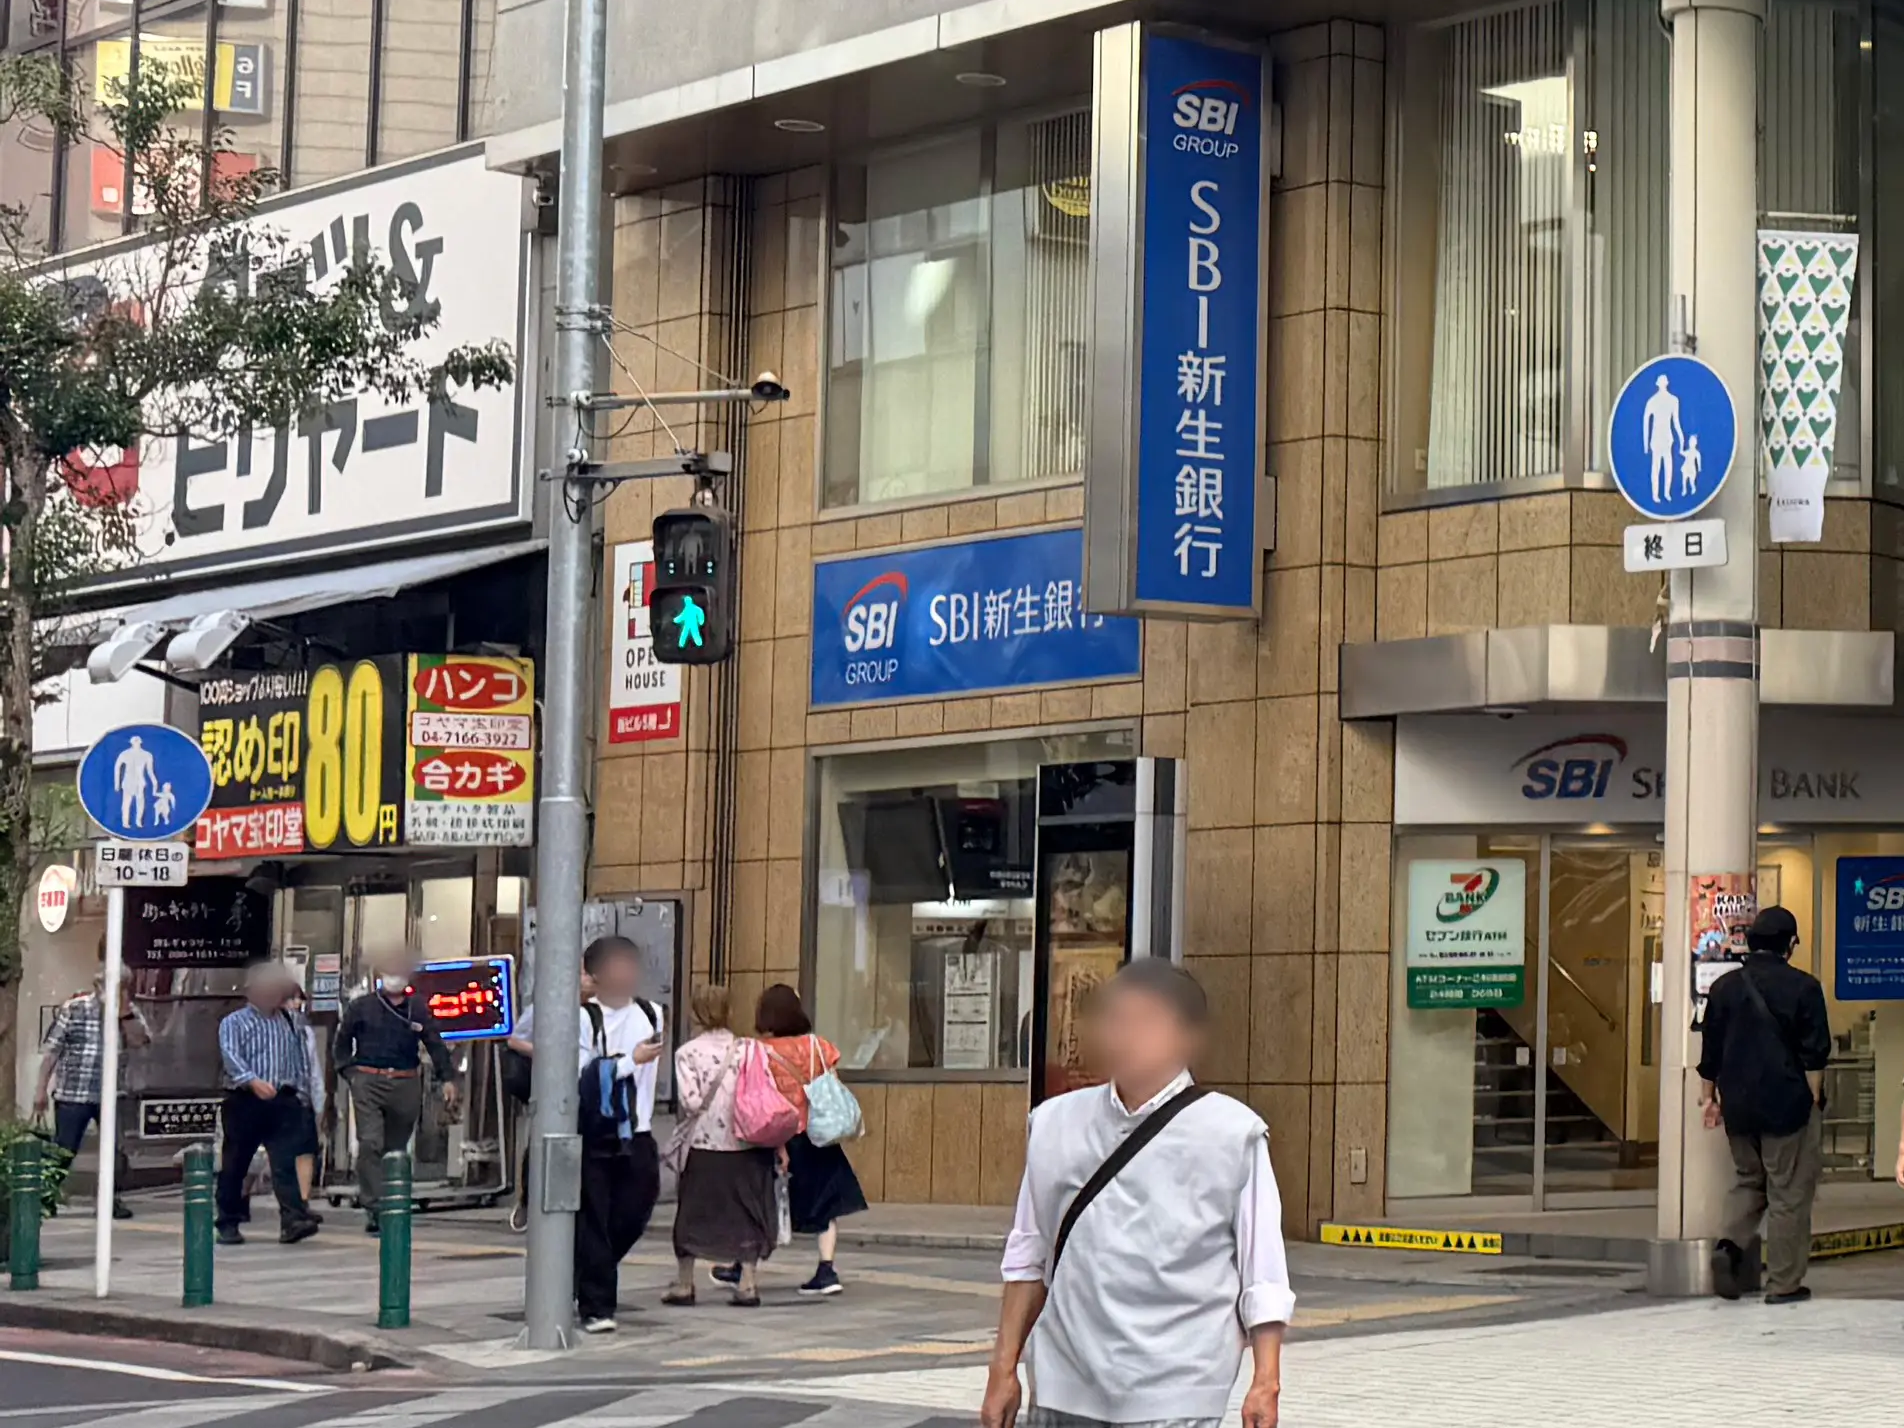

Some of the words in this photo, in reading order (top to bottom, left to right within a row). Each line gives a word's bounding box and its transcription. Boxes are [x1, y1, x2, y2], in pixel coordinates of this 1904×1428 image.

[1172, 93, 1239, 136] SBI
[1172, 133, 1239, 159] GROUP
[1173, 179, 1227, 579] SBI新生銀行
[1643, 532, 1704, 563] 終日
[844, 599, 900, 652] SBI
[626, 647, 658, 668] OPE
[845, 658, 898, 684] GROUP
[425, 667, 518, 701] ハンコ
[625, 671, 666, 690] HOUSE
[202, 711, 300, 787] 認め印
[421, 759, 515, 790] 合カギ
[1521, 759, 1614, 799] SBI
[1770, 768, 1862, 799] BANK
[195, 806, 304, 852] コヤマ宝印堂
[1445, 892, 1489, 905] BANK
